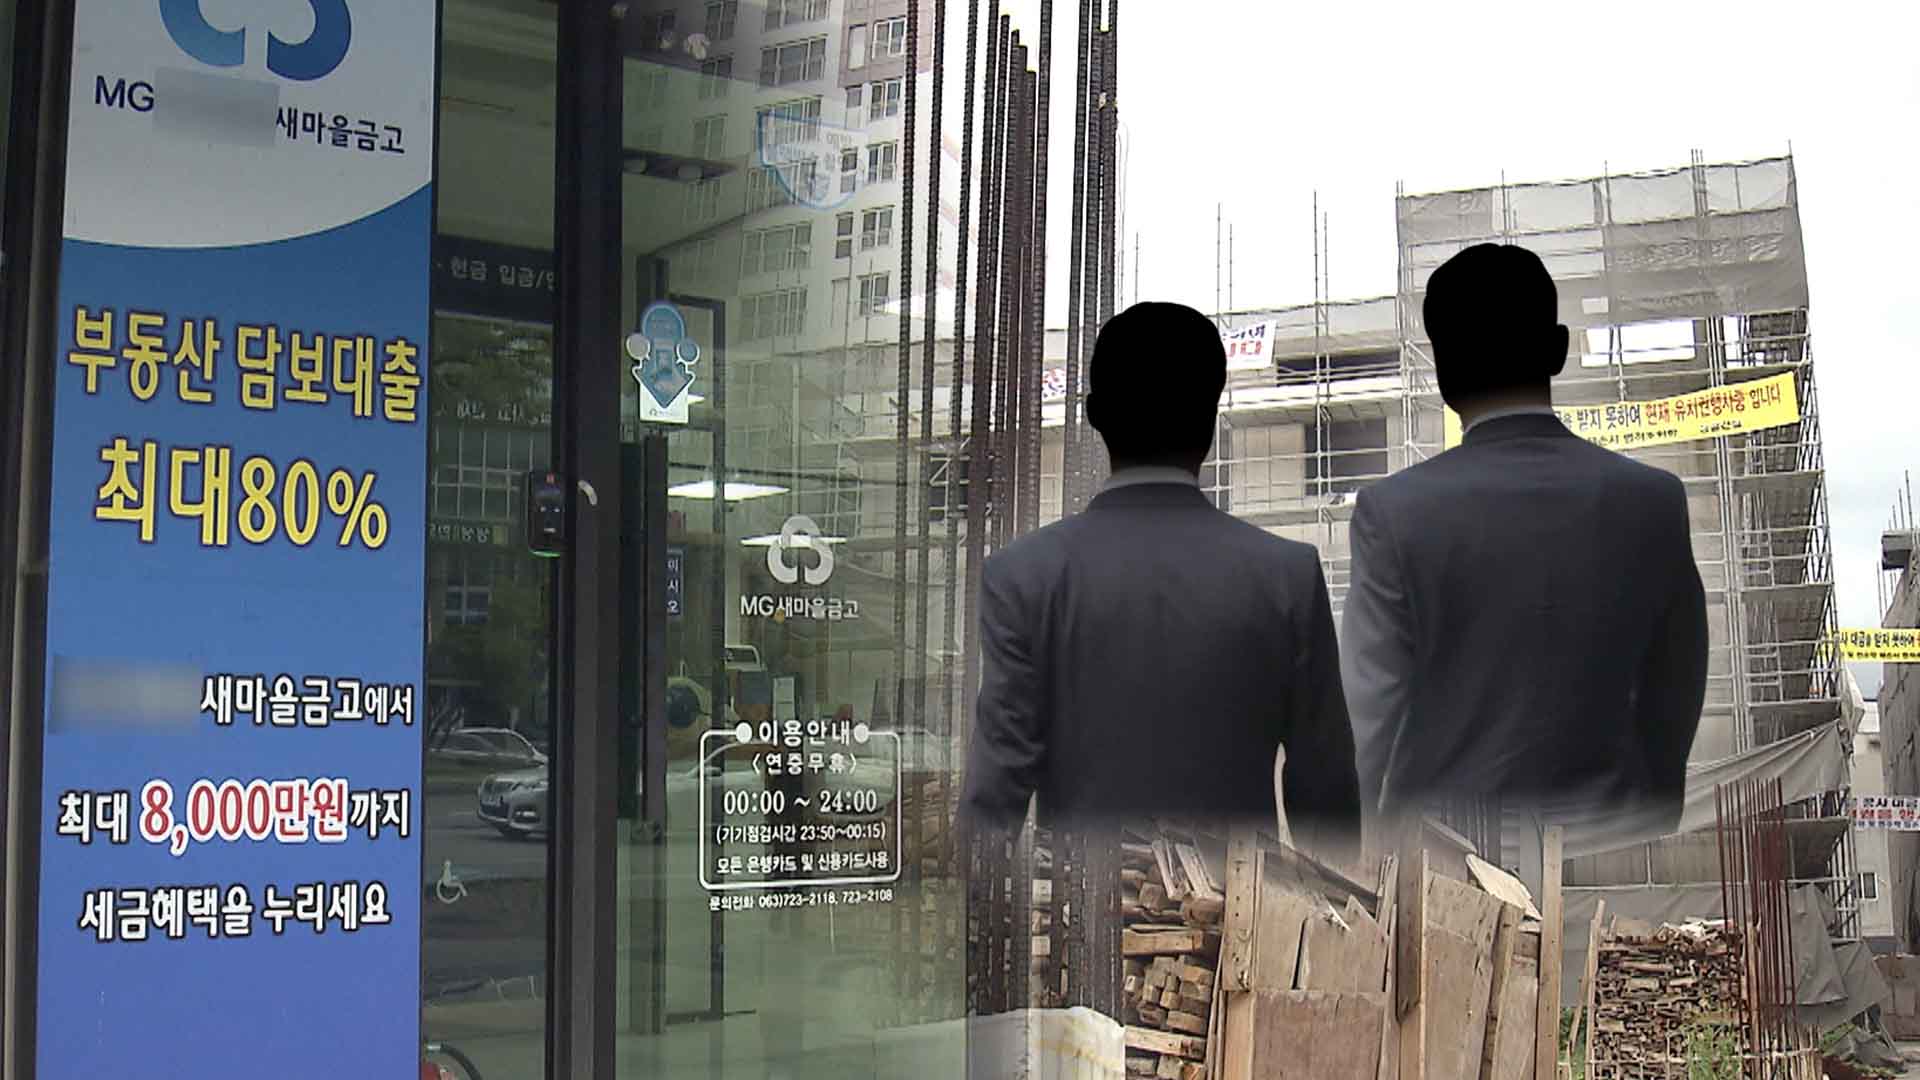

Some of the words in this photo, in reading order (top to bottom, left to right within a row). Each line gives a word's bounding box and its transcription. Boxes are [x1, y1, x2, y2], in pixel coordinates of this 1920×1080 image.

[94, 76, 154, 112] MG
[275, 111, 405, 154] 새마을금고
[68, 307, 220, 404] 부동산
[236, 325, 424, 424] 담보대출
[1606, 404, 1641, 430] 못하여
[1750, 383, 1781, 409] 입니다
[95, 437, 389, 548] 최대80%
[740, 595, 859, 620] MG새마을금고
[199, 674, 414, 725] 새마을금고에서
[759, 720, 850, 747] 이용안내
[58, 790, 128, 843] 최대
[140, 778, 411, 857] 8,000만원까지
[723, 790, 785, 815] 00:00
[820, 790, 877, 813] 24:00
[716, 824, 796, 844] (기기점검시간
[801, 823, 886, 842] 23:50~00:15)
[717, 856, 743, 874] 모든
[747, 854, 797, 873] 은행카드
[801, 853, 814, 871] 및
[818, 851, 889, 872] 신용카드사용
[79, 887, 252, 941] 세금혜택을
[263, 883, 390, 935] 누리세요
